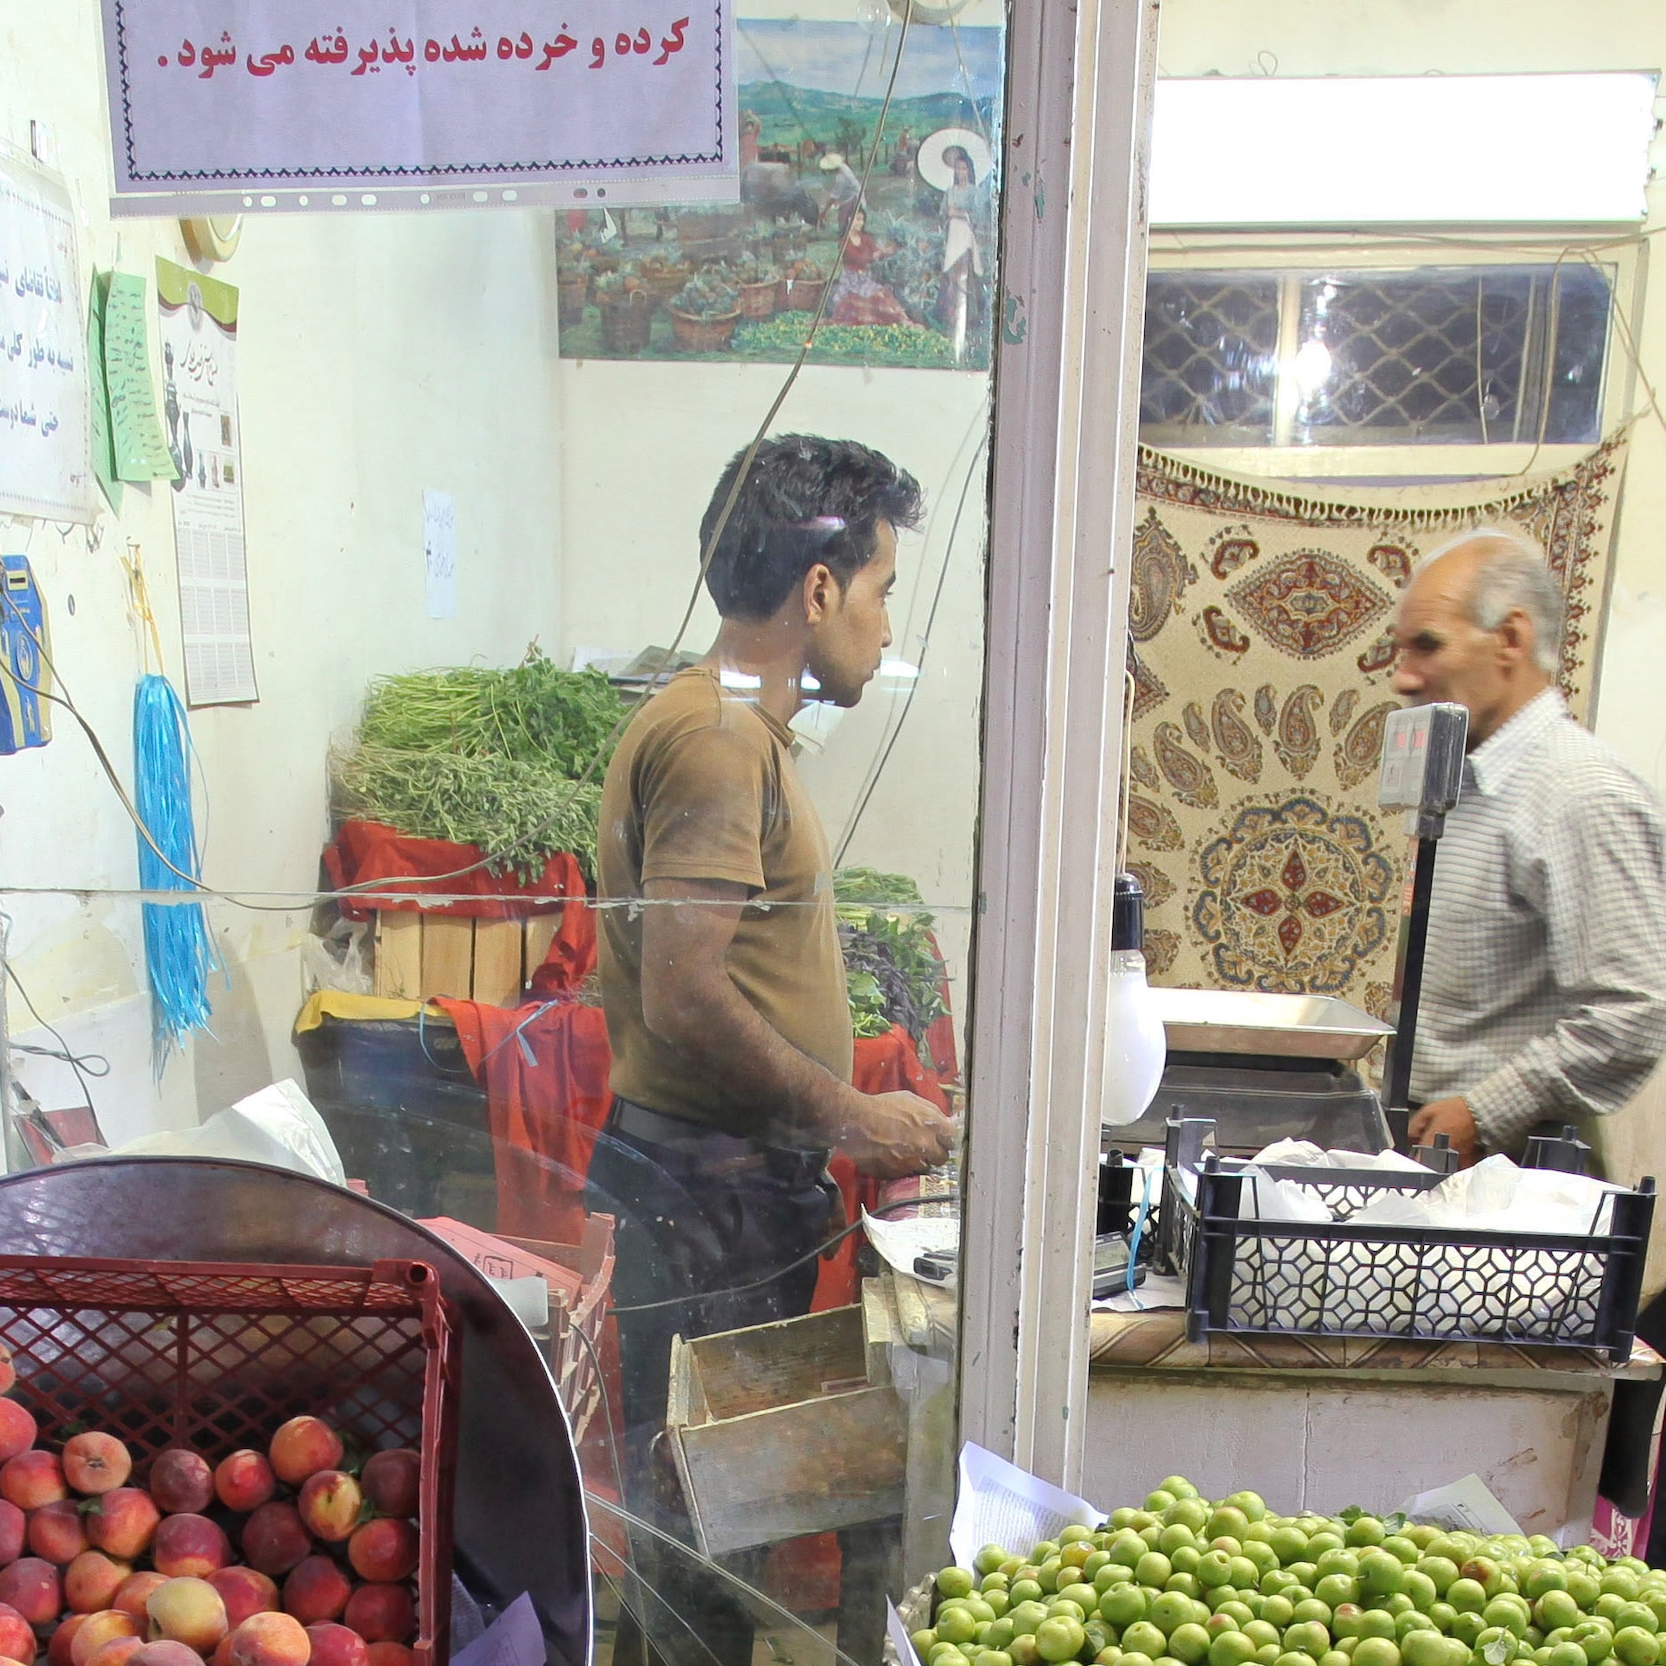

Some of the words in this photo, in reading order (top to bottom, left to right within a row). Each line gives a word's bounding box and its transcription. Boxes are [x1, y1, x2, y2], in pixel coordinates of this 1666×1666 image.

[245, 44, 296, 78] می
[304, 26, 416, 78] پذیرفته
[423, 26, 488, 63] شده
[496, 22, 578, 71] خرده
[588, 37, 606, 69] و
[613, 17, 690, 66] کرده
